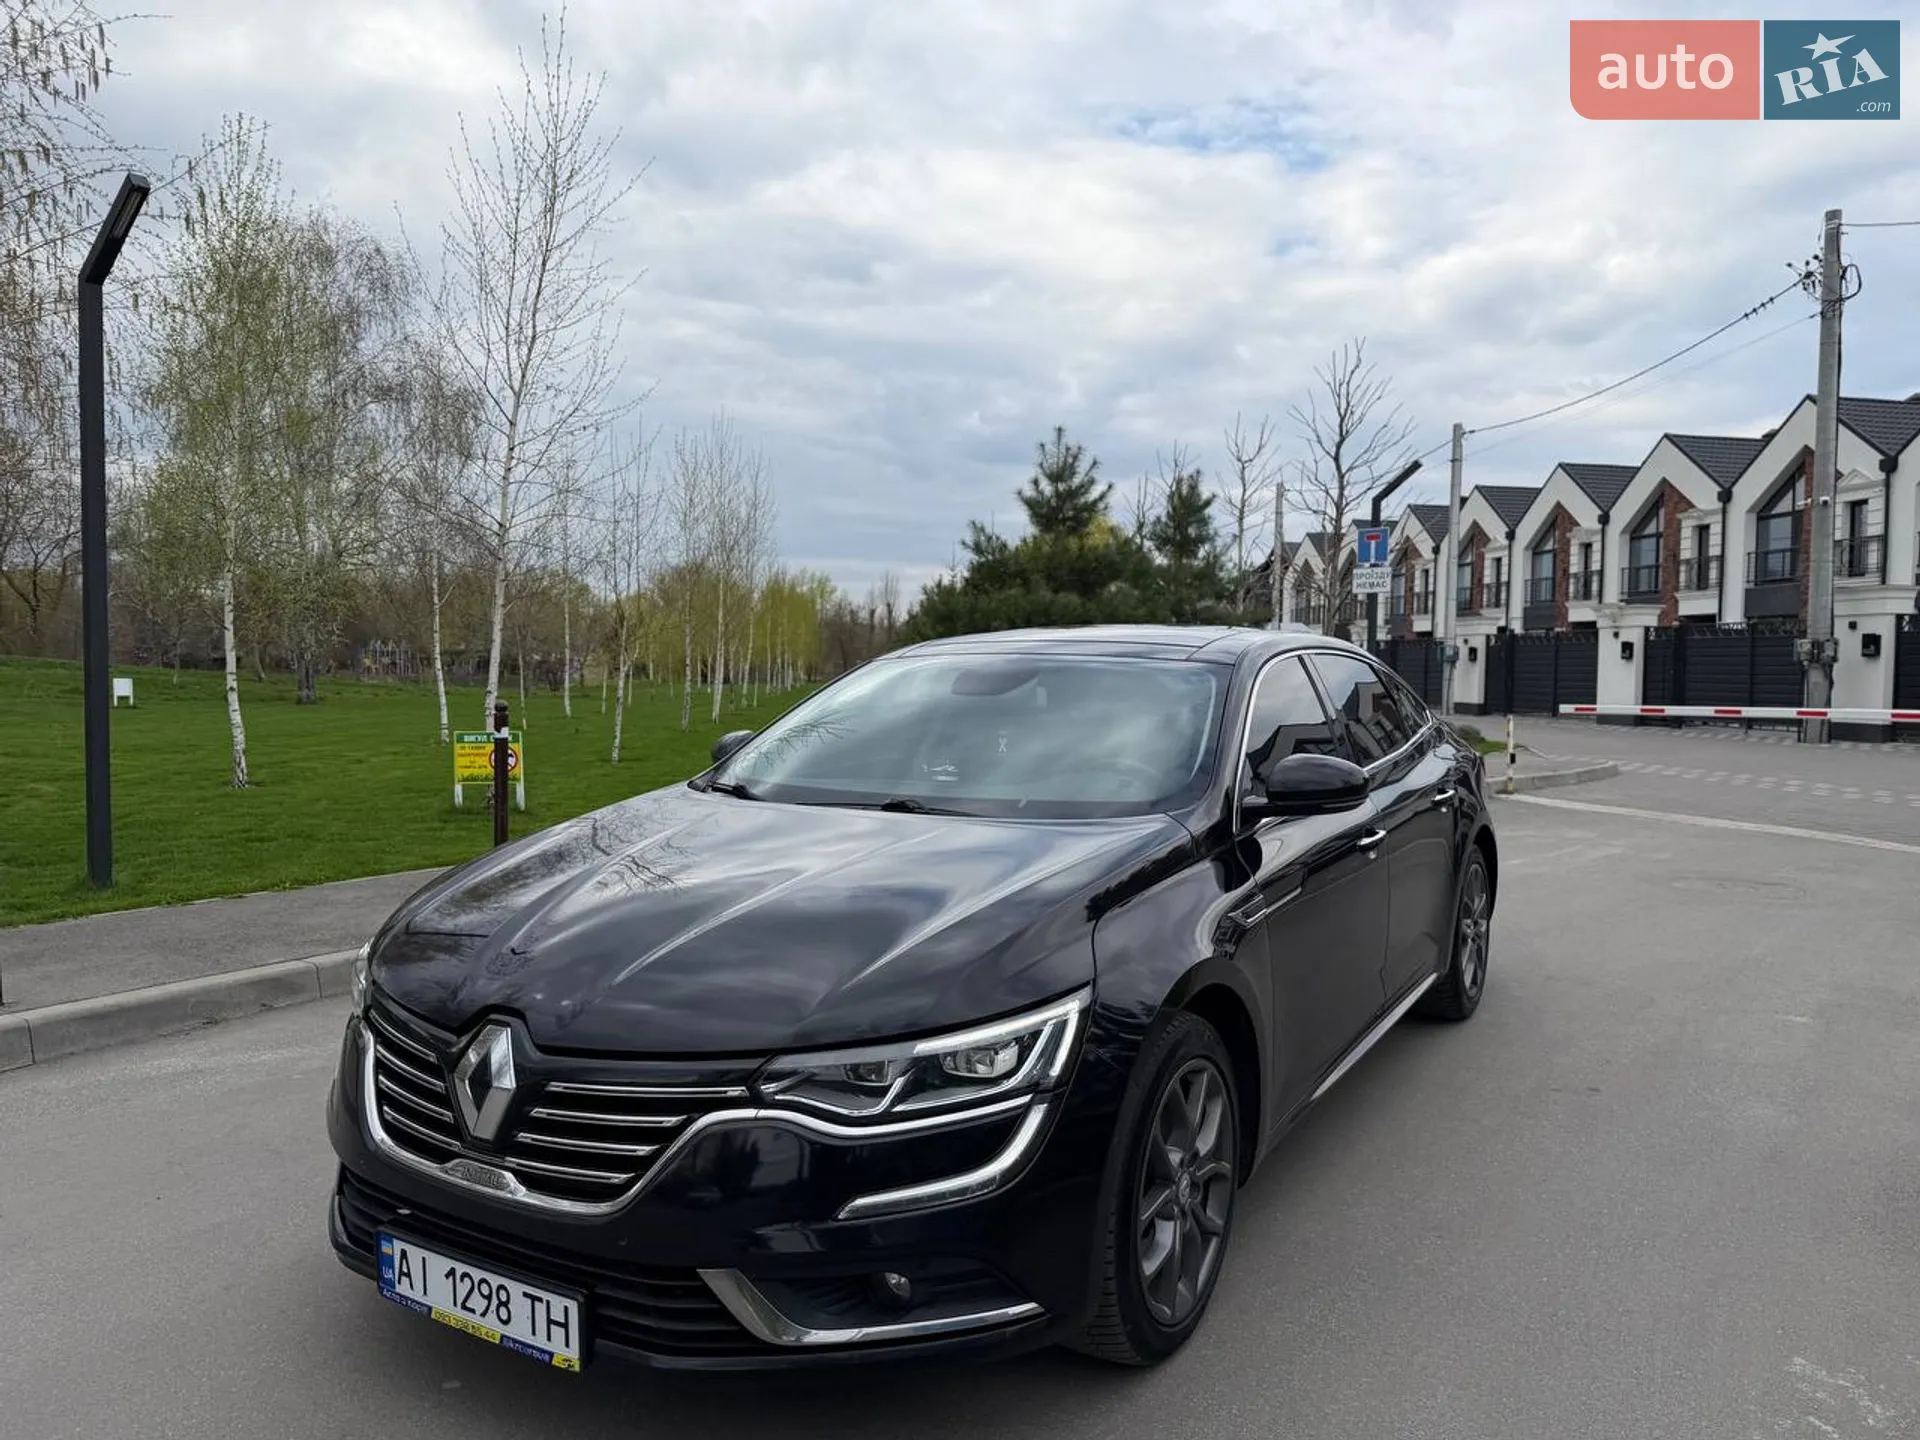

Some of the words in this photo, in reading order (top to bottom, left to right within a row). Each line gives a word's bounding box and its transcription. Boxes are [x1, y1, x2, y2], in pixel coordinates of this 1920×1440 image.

[382, 1265, 395, 1282] UA
[397, 1248, 428, 1296] AI
[444, 1266, 512, 1326] 1298
[522, 1291, 571, 1349] TH
